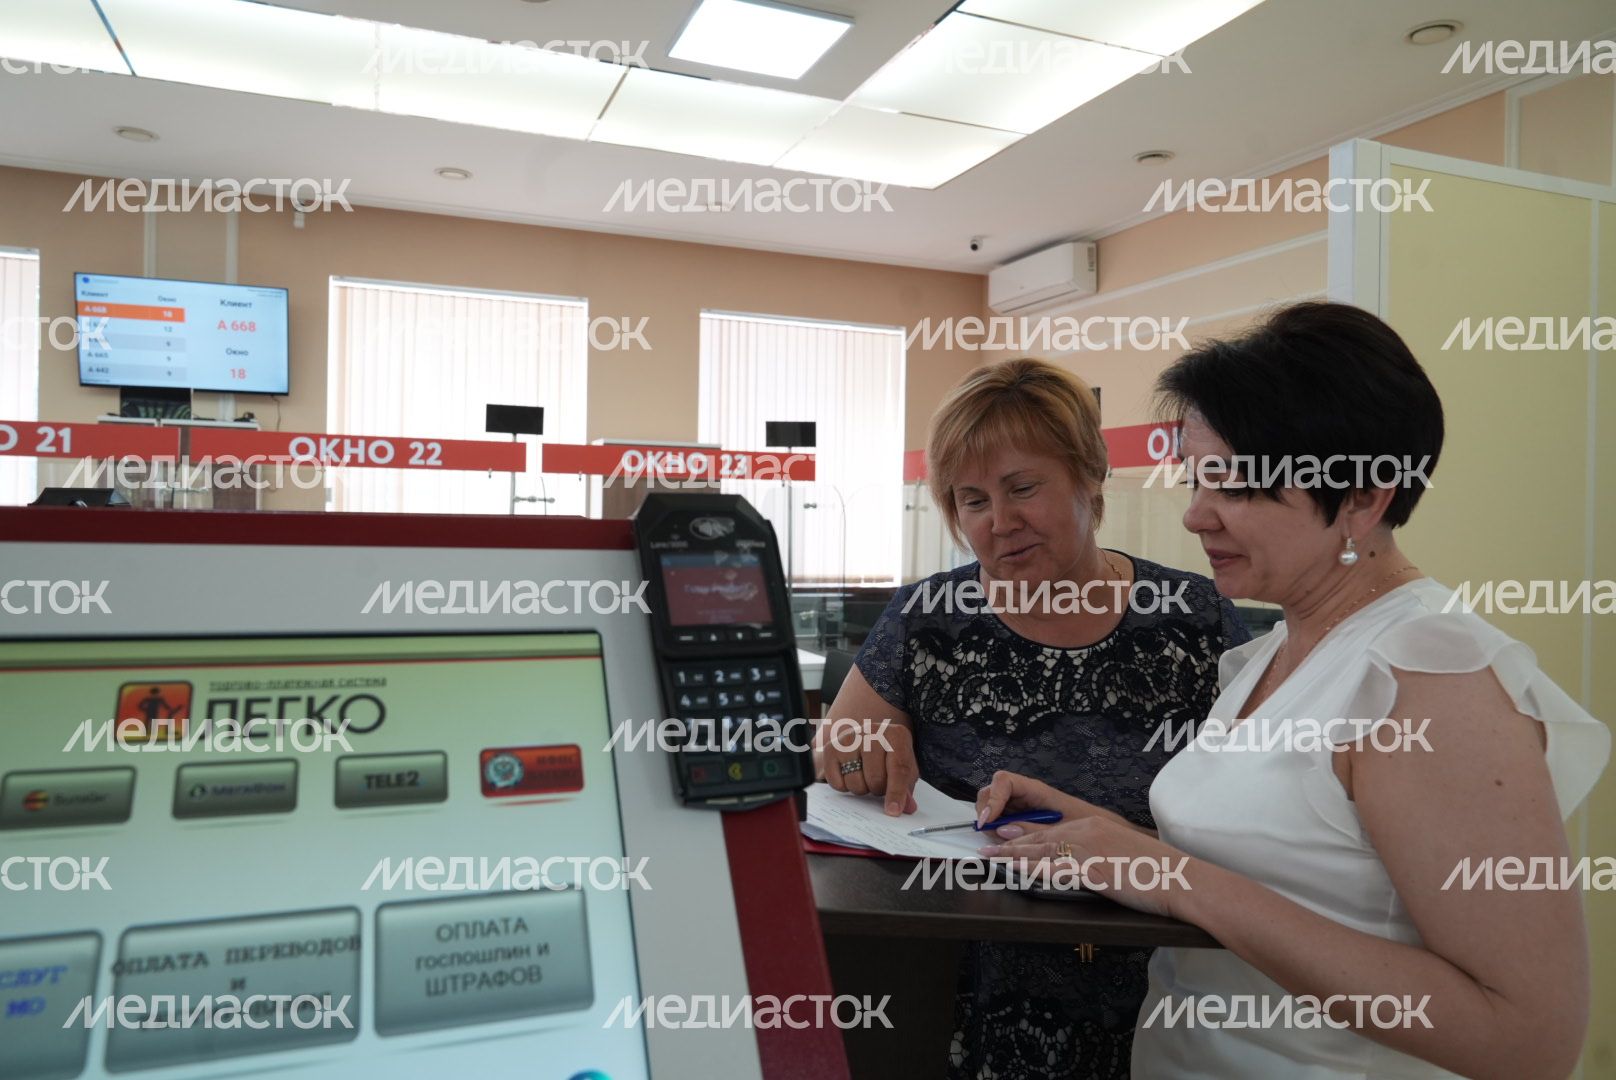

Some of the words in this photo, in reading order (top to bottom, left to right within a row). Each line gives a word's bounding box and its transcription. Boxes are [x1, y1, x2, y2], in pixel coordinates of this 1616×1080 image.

[220, 299, 252, 309] Клиент
[231, 320, 257, 333] 668
[225, 347, 249, 357] Окно
[230, 367, 247, 380] 18
[36, 426, 72, 453] 21
[288, 436, 395, 465] ОКНО
[408, 442, 443, 466] 22
[621, 449, 708, 475] ОКНО
[197, 693, 387, 742] ЛЕГКО
[364, 770, 421, 791] TELE2
[435, 916, 529, 944] ОПЛАТА
[111, 952, 209, 977] ОПЛАТА
[225, 934, 361, 966] ПЕРЕВОДОВ
[415, 945, 531, 972] госпошлин
[425, 964, 543, 998] ШТРАФОВ
